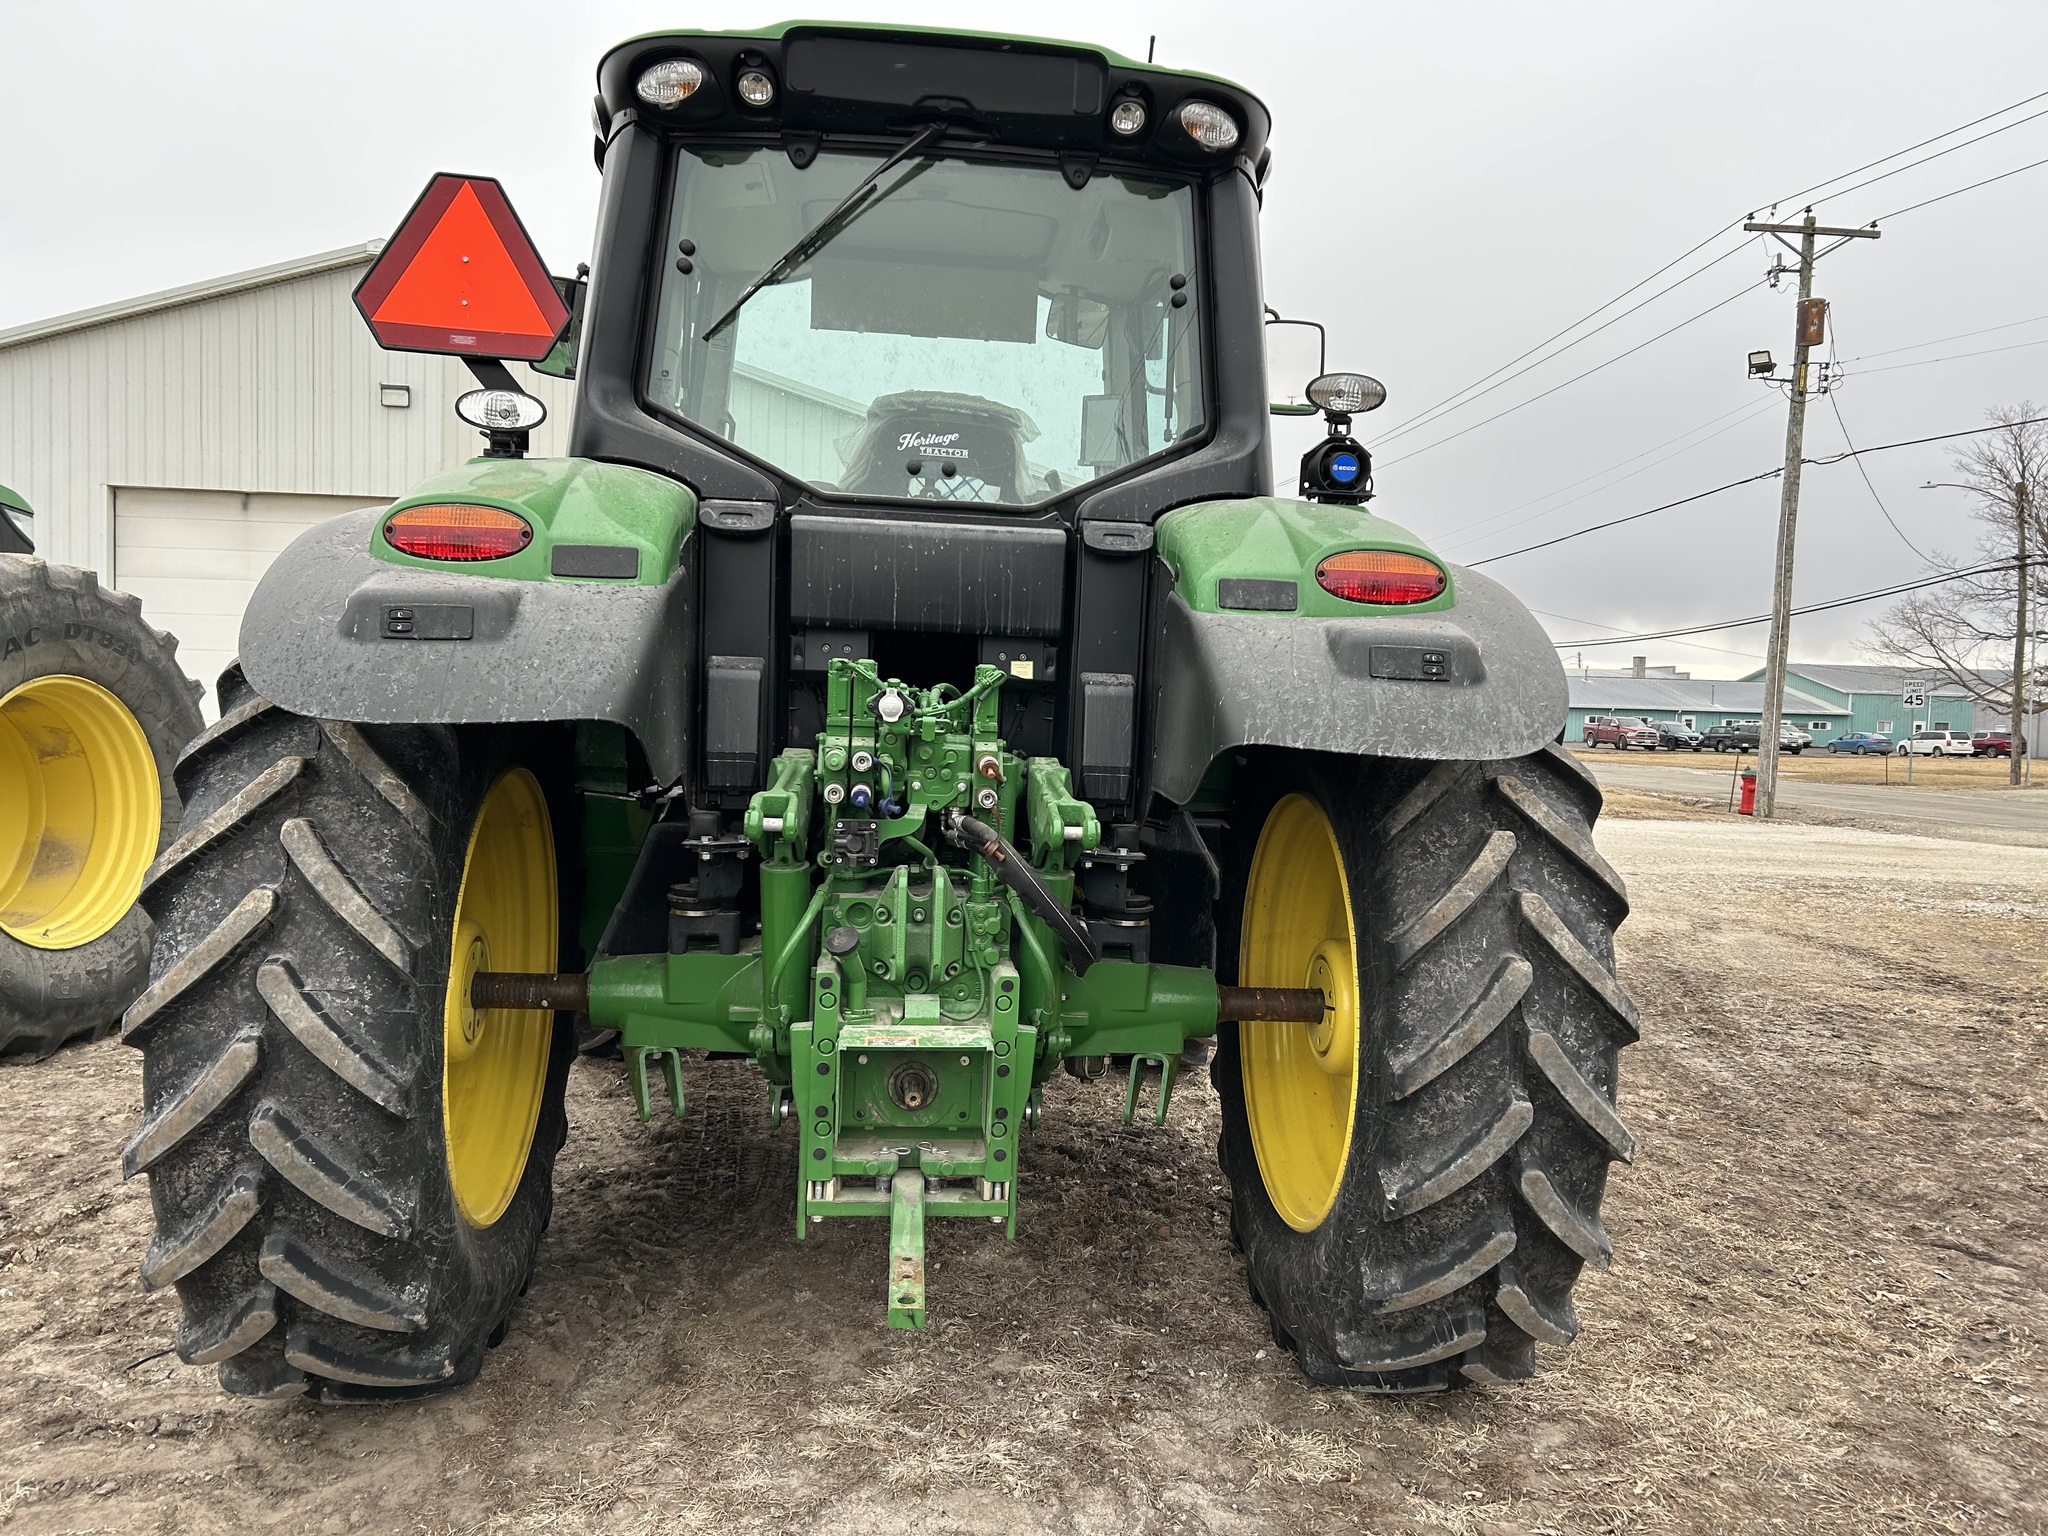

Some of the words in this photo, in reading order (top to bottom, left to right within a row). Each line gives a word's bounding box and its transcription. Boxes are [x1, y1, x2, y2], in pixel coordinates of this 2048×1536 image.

[897, 431, 960, 451] Heritage
[920, 448, 969, 458] TRACTOR
[1903, 694, 1924, 706] 45
